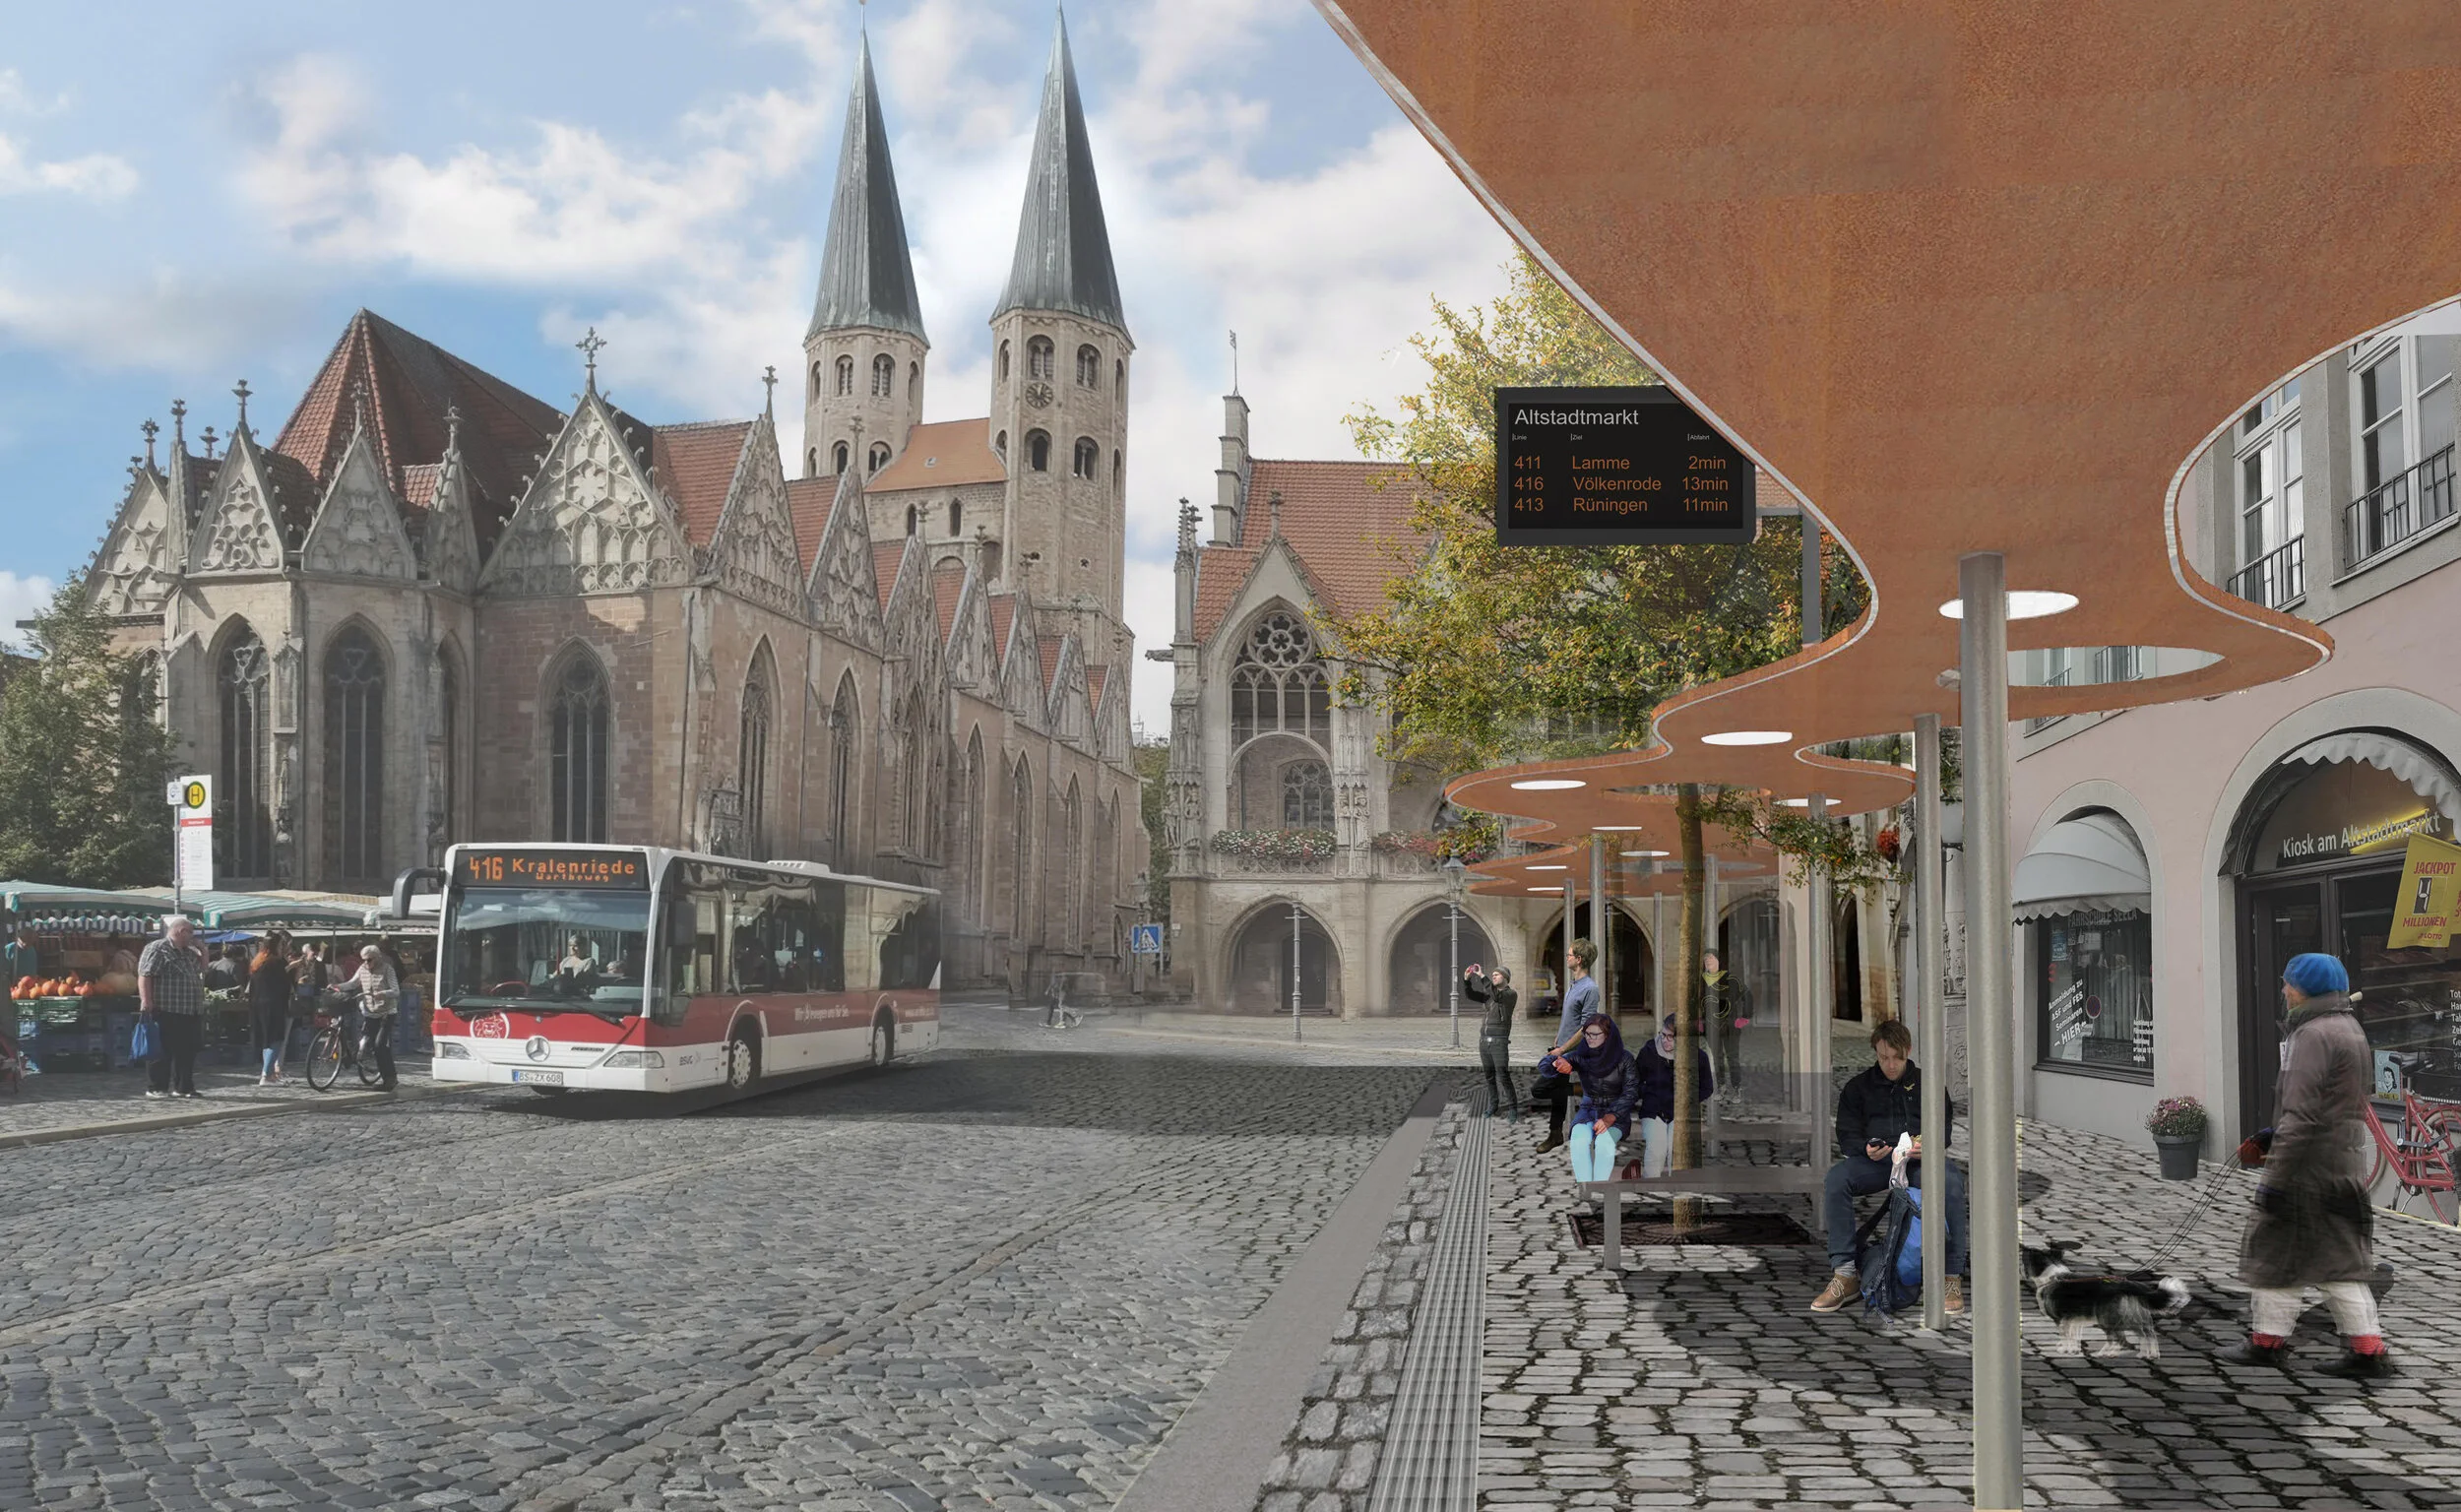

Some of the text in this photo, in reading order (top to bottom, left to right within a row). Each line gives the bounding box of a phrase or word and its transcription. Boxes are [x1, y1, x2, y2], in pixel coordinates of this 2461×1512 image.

[1514, 409, 1639, 425] Altstadtmarkt
[1514, 456, 1727, 470] 411 Lamme 2min
[1514, 476, 1729, 490] 416 Völkenrode 13min
[1514, 497, 1729, 515] 413 Rüningen 11min
[2283, 810, 2441, 858] Kiosk am Altstadtmarkt
[470, 855, 636, 881] 416 Kralenriede
[2413, 861, 2457, 875] JACKPOT
[2403, 915, 2447, 928] MILLIONEN
[2049, 978, 2083, 1011] Anmeldung zu
[2051, 990, 2084, 1022] ASF und FES
[2055, 1006, 2083, 1032] Seminaren
[2060, 1022, 2081, 1045] HIER
